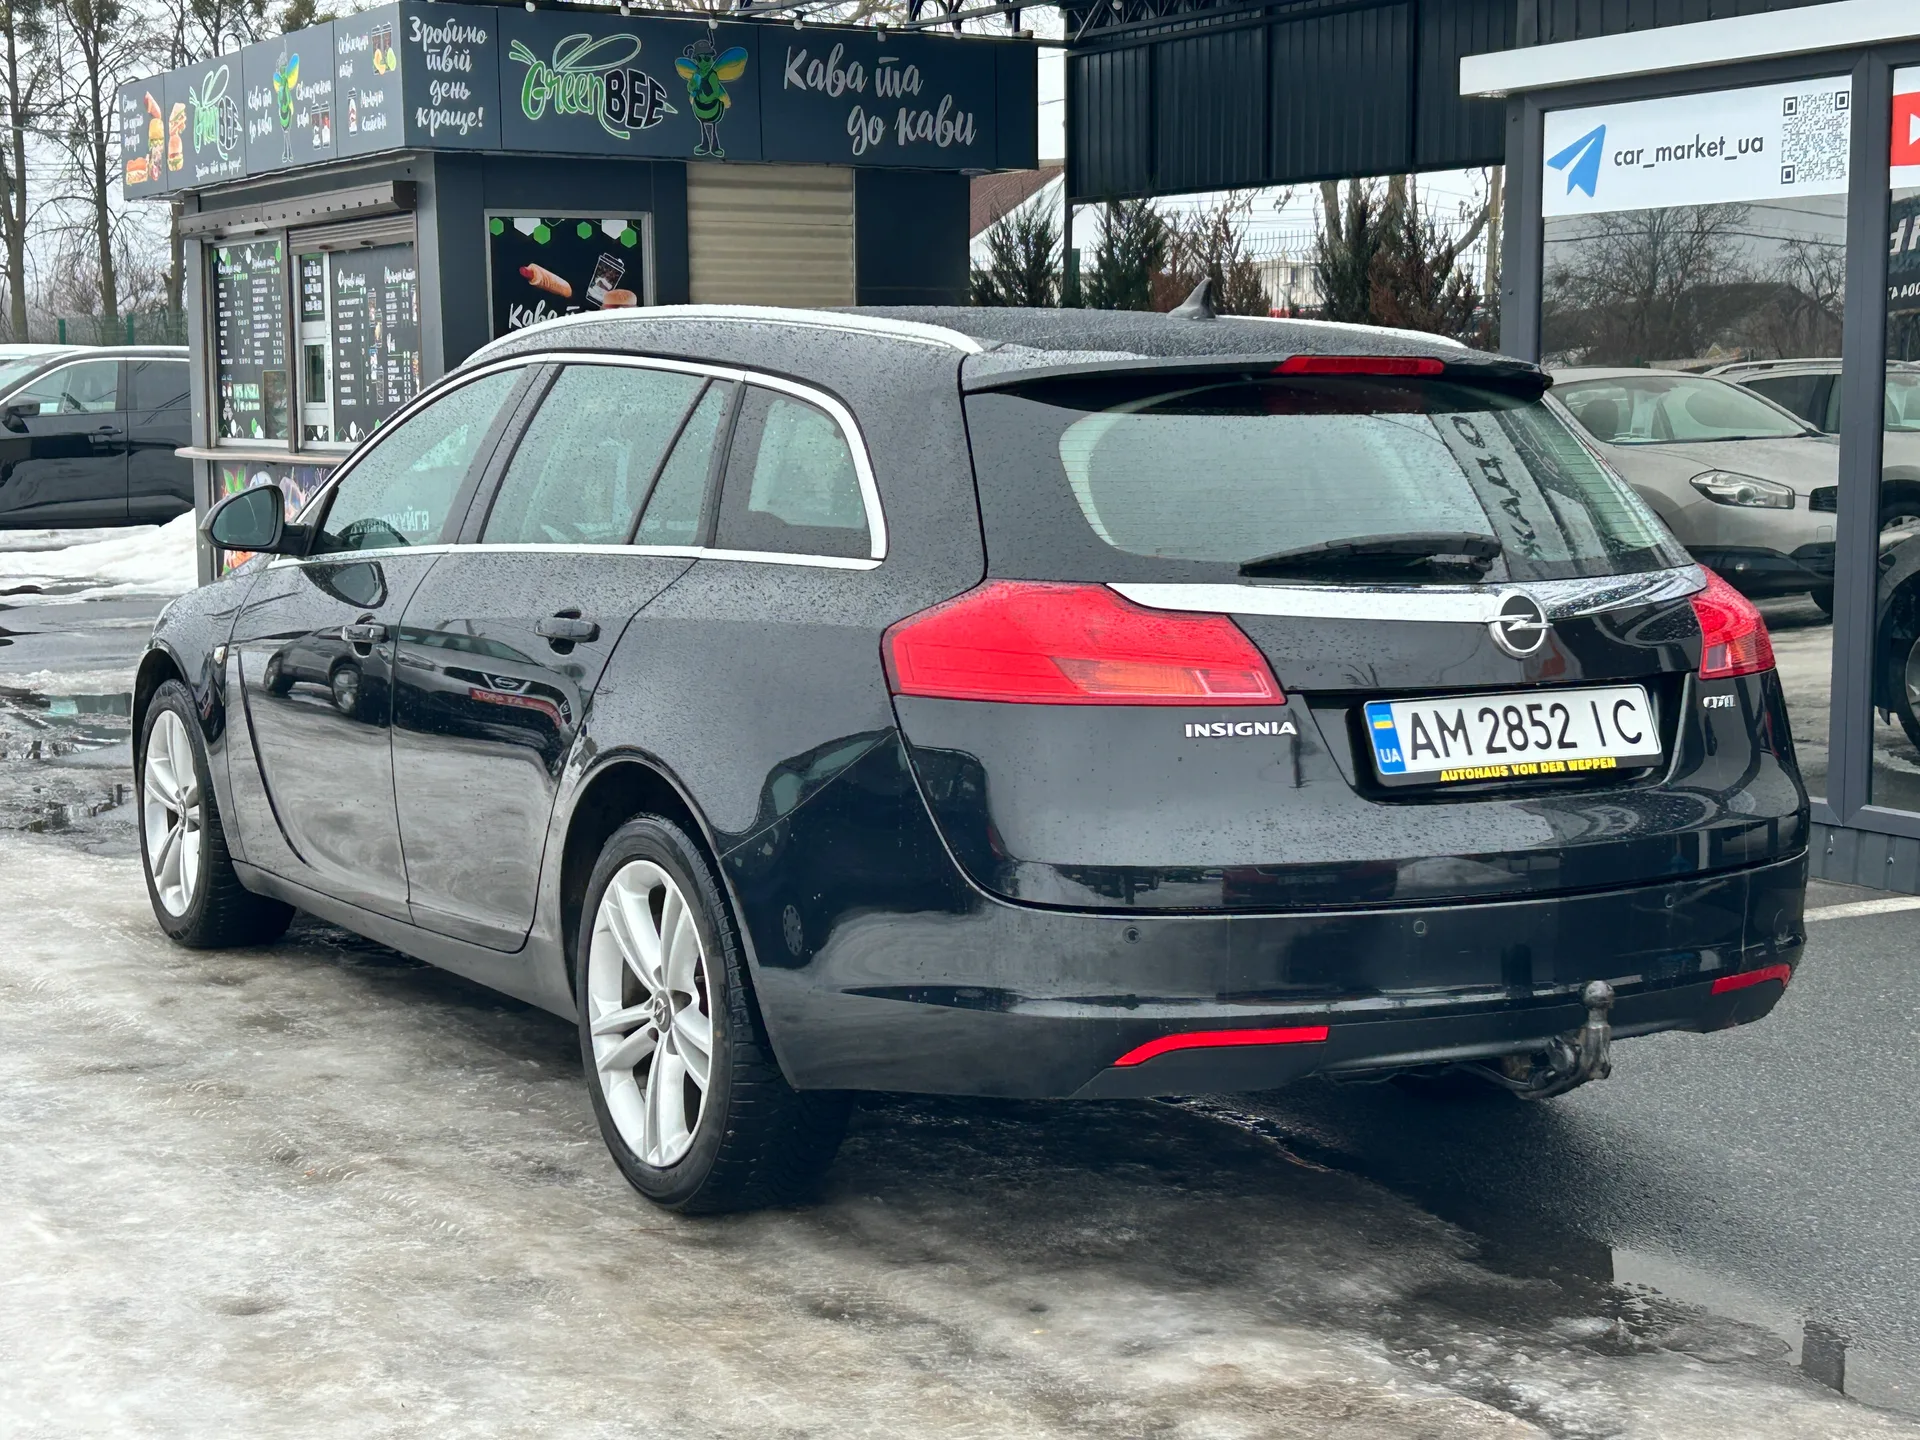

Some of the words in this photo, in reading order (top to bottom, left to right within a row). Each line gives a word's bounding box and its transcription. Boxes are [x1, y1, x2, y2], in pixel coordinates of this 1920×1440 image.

[409, 16, 487, 51] Зробимо
[426, 45, 472, 73] твій
[783, 43, 867, 98] Кава
[875, 56, 923, 98] та
[429, 79, 471, 106] день
[415, 106, 484, 137] краще!
[847, 104, 886, 156] до
[894, 93, 977, 148] кави
[1613, 133, 1764, 169] car_market_ua
[1184, 721, 1298, 738] INSIGNIA
[1411, 708, 1473, 760] AM
[1478, 702, 1578, 754] 2852
[1380, 748, 1402, 763] UA
[1440, 765, 1509, 782] AUTOHAUS
[1511, 763, 1538, 775] VON
[1540, 761, 1565, 774] DER
[1567, 757, 1617, 772] WEPPEN
